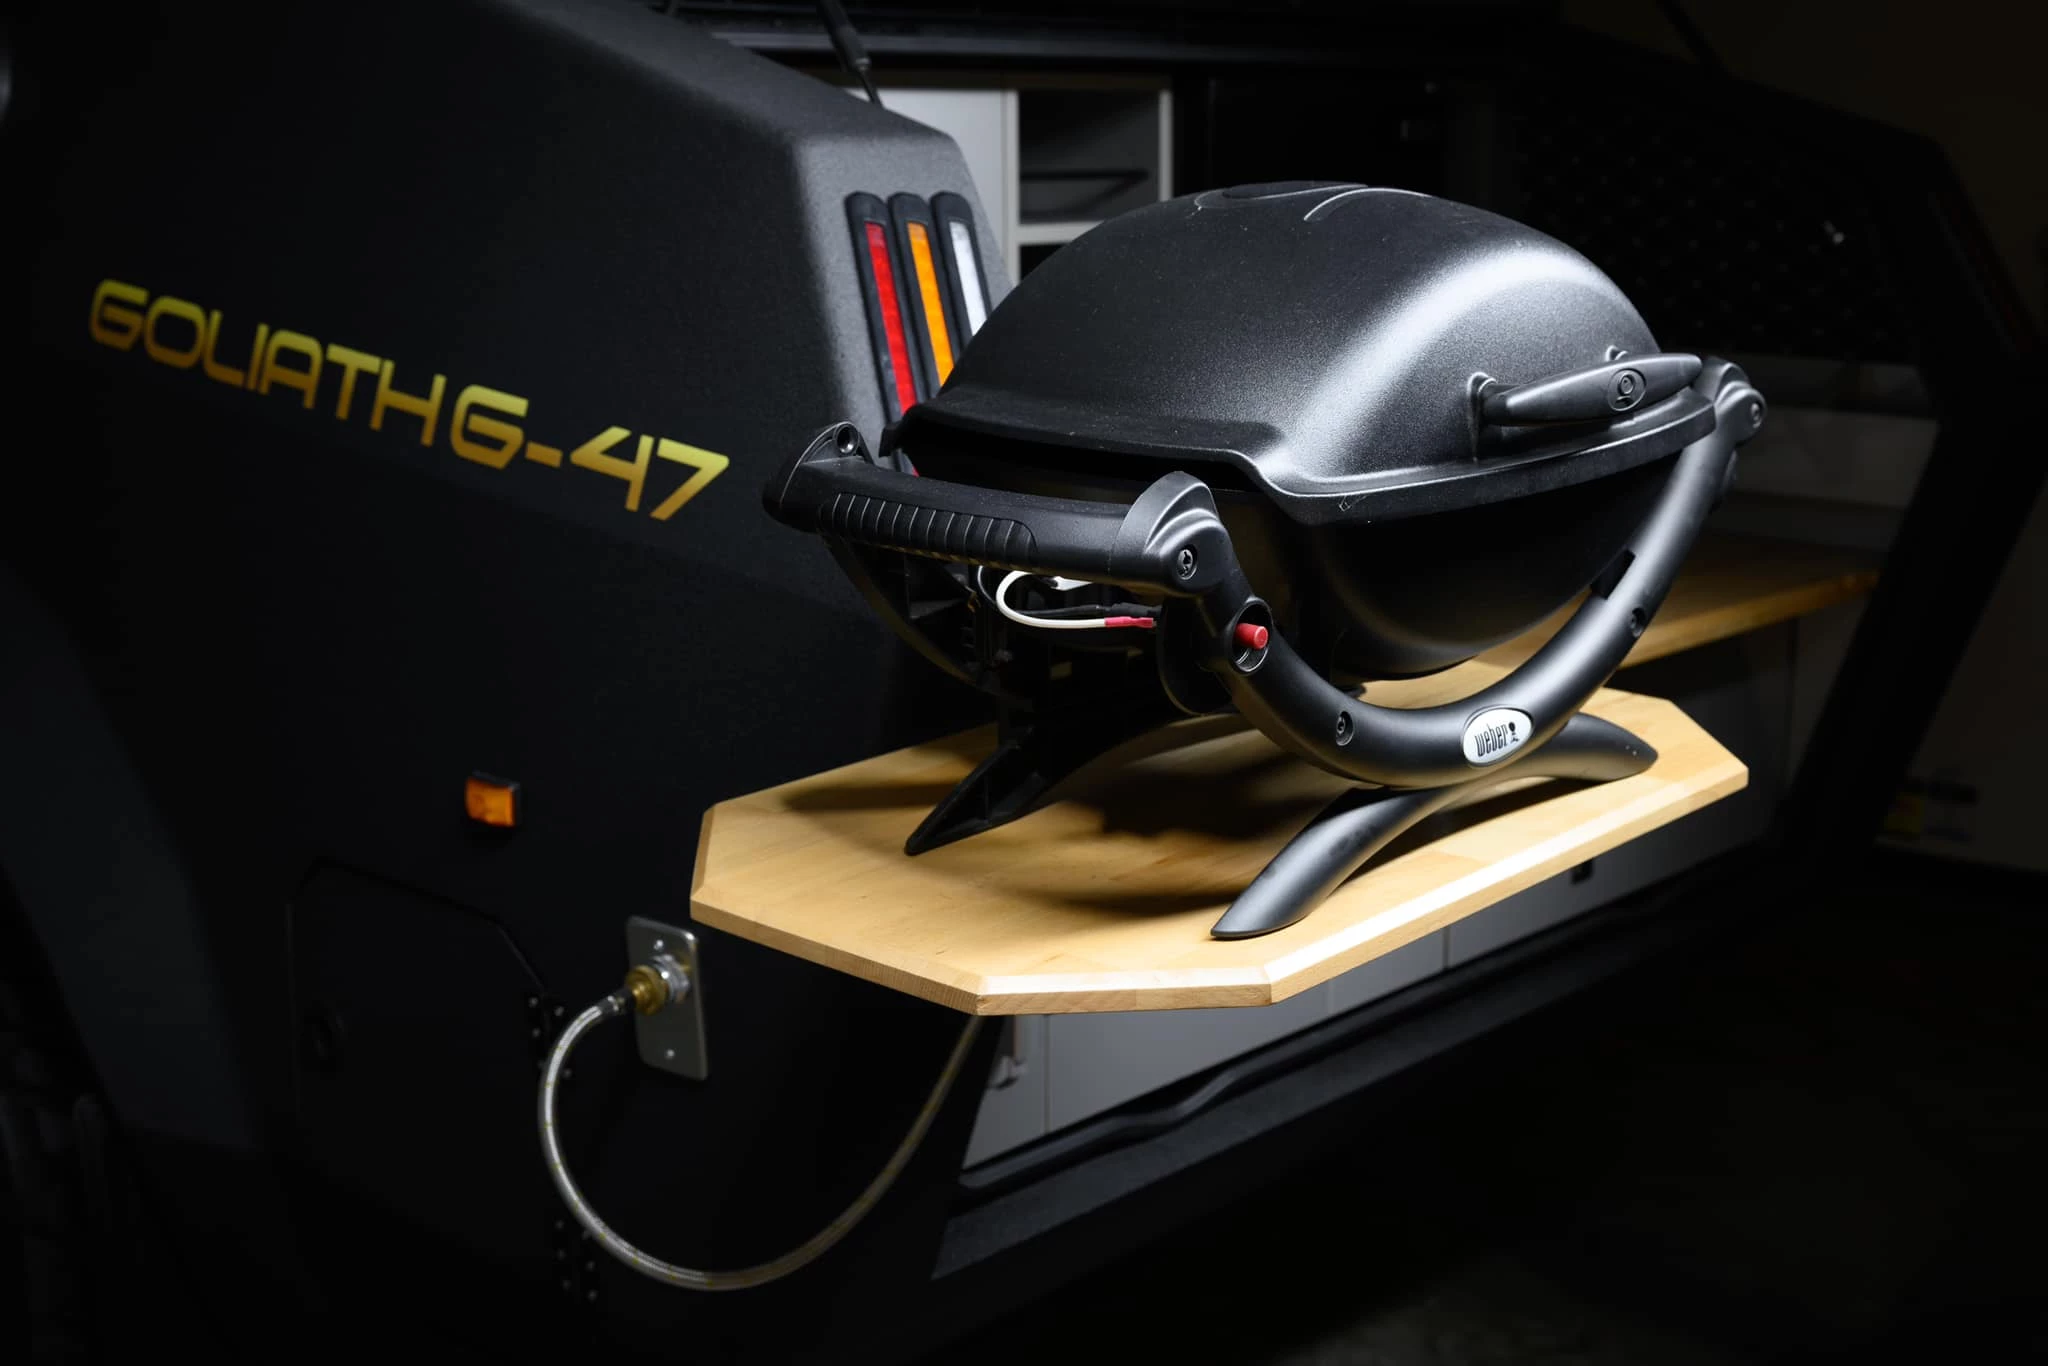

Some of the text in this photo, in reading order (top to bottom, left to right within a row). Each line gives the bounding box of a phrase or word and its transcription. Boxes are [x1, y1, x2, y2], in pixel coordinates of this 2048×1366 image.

[90, 279, 730, 521] GOLIATH G-47
[1474, 722, 1509, 757] weber
